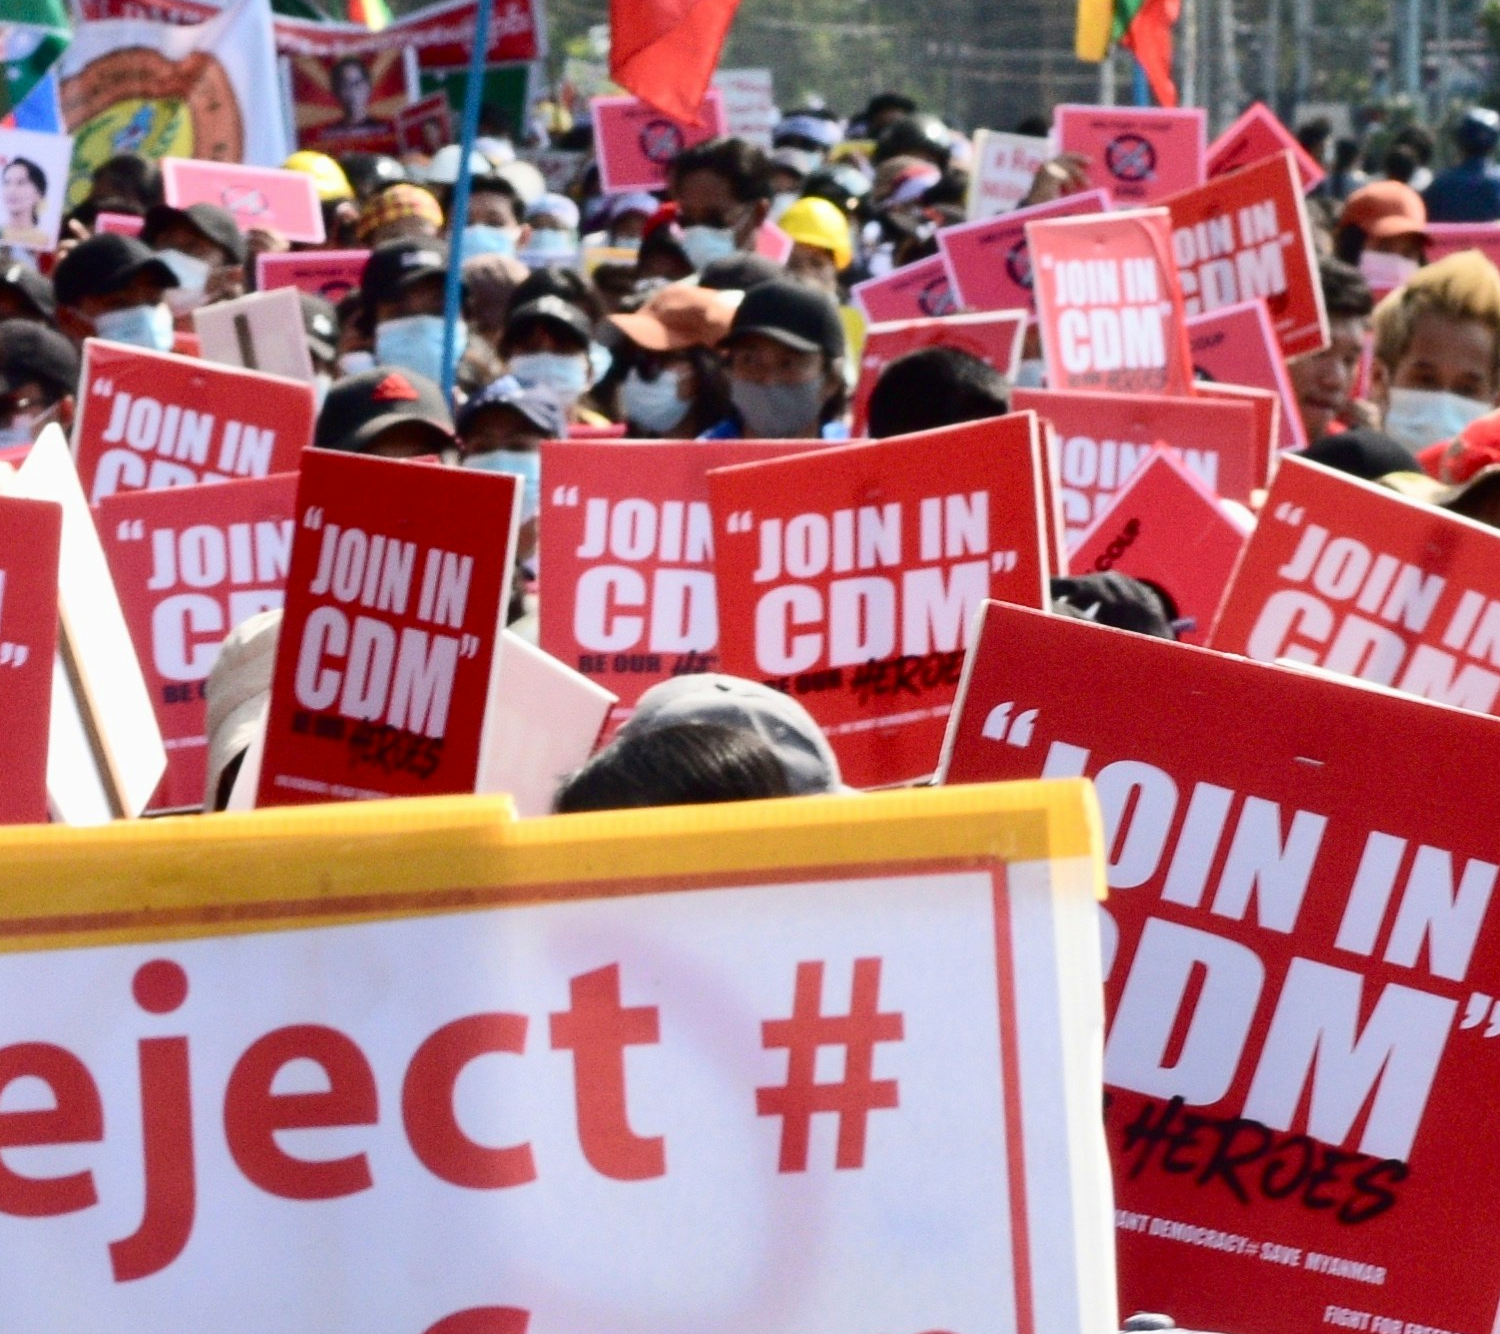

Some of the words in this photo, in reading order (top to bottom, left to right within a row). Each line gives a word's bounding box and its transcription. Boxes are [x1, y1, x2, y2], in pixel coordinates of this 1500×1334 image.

[1173, 213, 1235, 270] OIN
[1237, 199, 1282, 248] IN
[1122, 256, 1158, 304] IN
[217, 421, 276, 478] IN
[303, 505, 417, 616] “JOIN
[416, 548, 475, 629] IN
[726, 502, 901, 584] “JOIN
[919, 490, 990, 562] IN
[1273, 501, 1447, 635] “JOIN
[574, 565, 720, 654] CD
[294, 605, 480, 741] CDM”
[848, 650, 966, 704] HEROE
[754, 954, 906, 1174] #
[1122, 1093, 1411, 1226] HEROES
[1115, 1208, 1151, 1234] ANT
[1258, 1241, 1303, 1269] SAVE
[1303, 1250, 1388, 1286] MYANMAR
[1322, 1304, 1374, 1331] FIGHT
